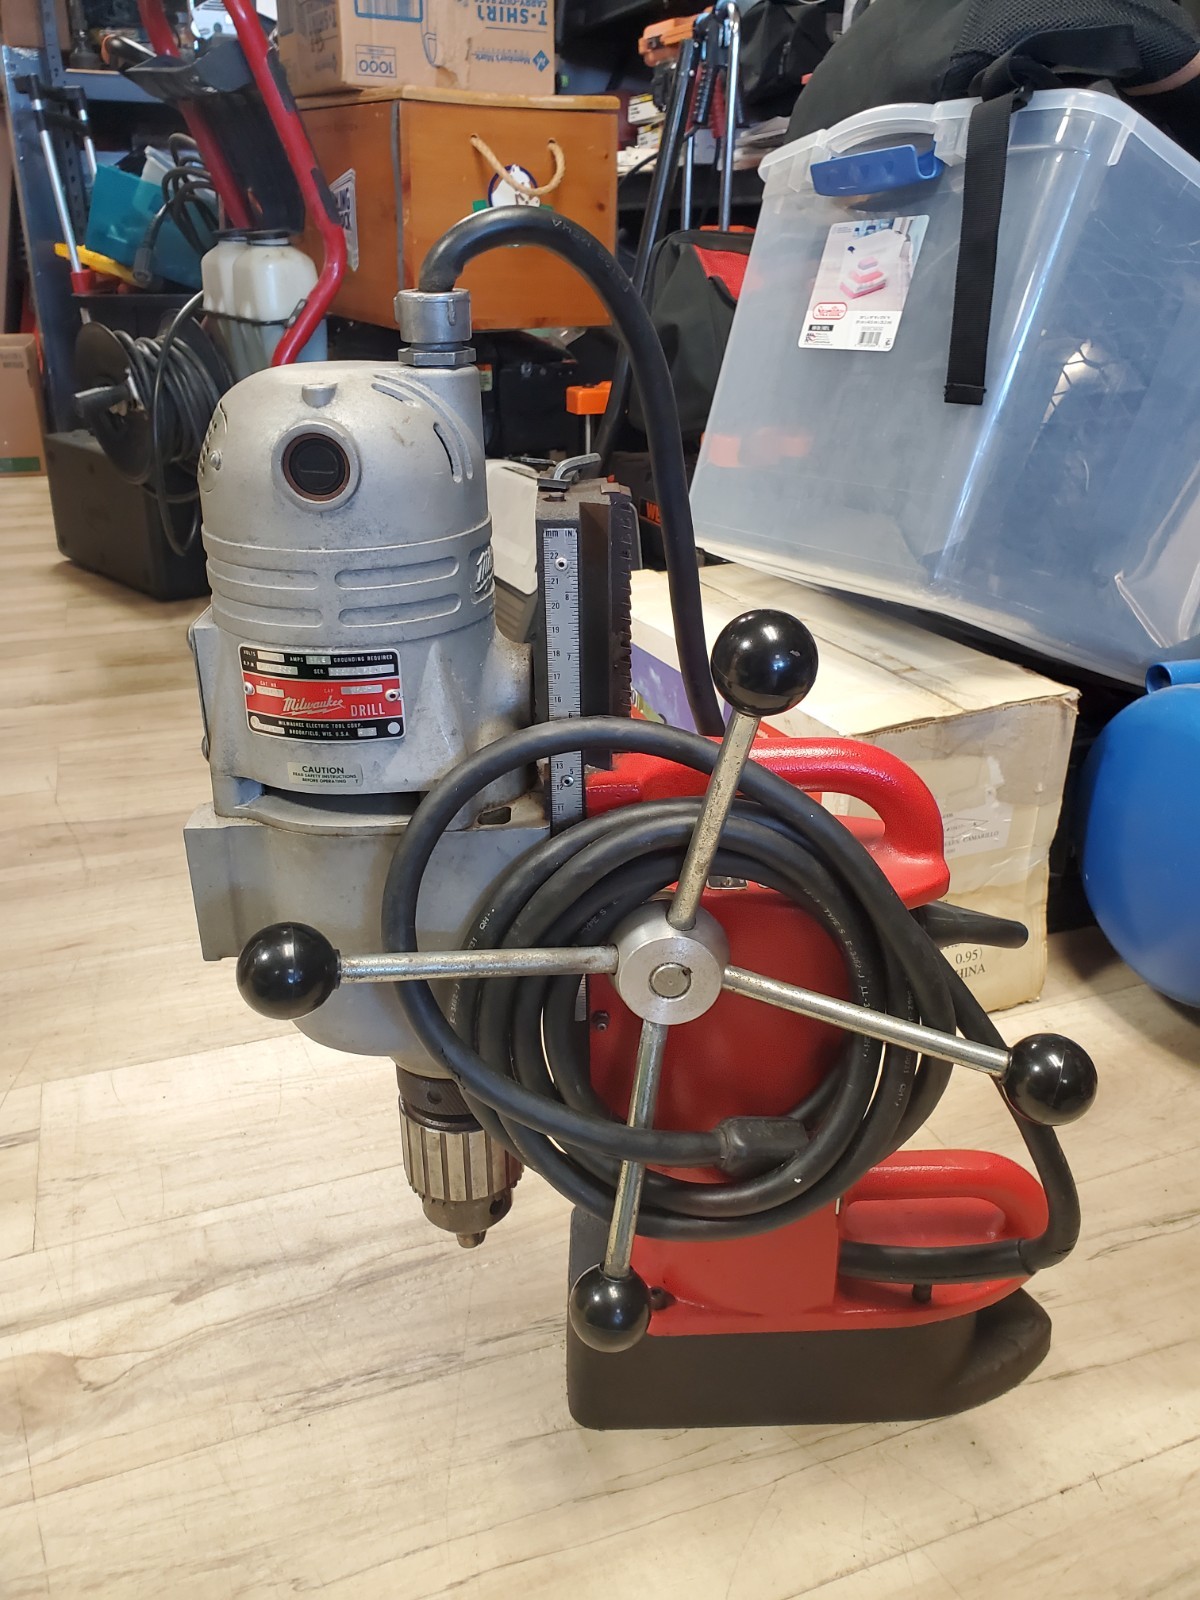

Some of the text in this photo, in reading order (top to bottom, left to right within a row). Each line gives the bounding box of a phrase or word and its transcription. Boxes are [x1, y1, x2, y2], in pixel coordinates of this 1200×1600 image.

[359, 59, 394, 75] 1000
[545, 530, 559, 538] mm
[550, 552, 559, 560] 22
[551, 602, 560, 610] 20
[552, 626, 560, 634] 19
[366, 654, 394, 662] REQUIRED
[283, 695, 386, 717] Milwaukee DRILL
[302, 765, 345, 775] CAUTION
[962, 830, 999, 842] CAMARILLO
